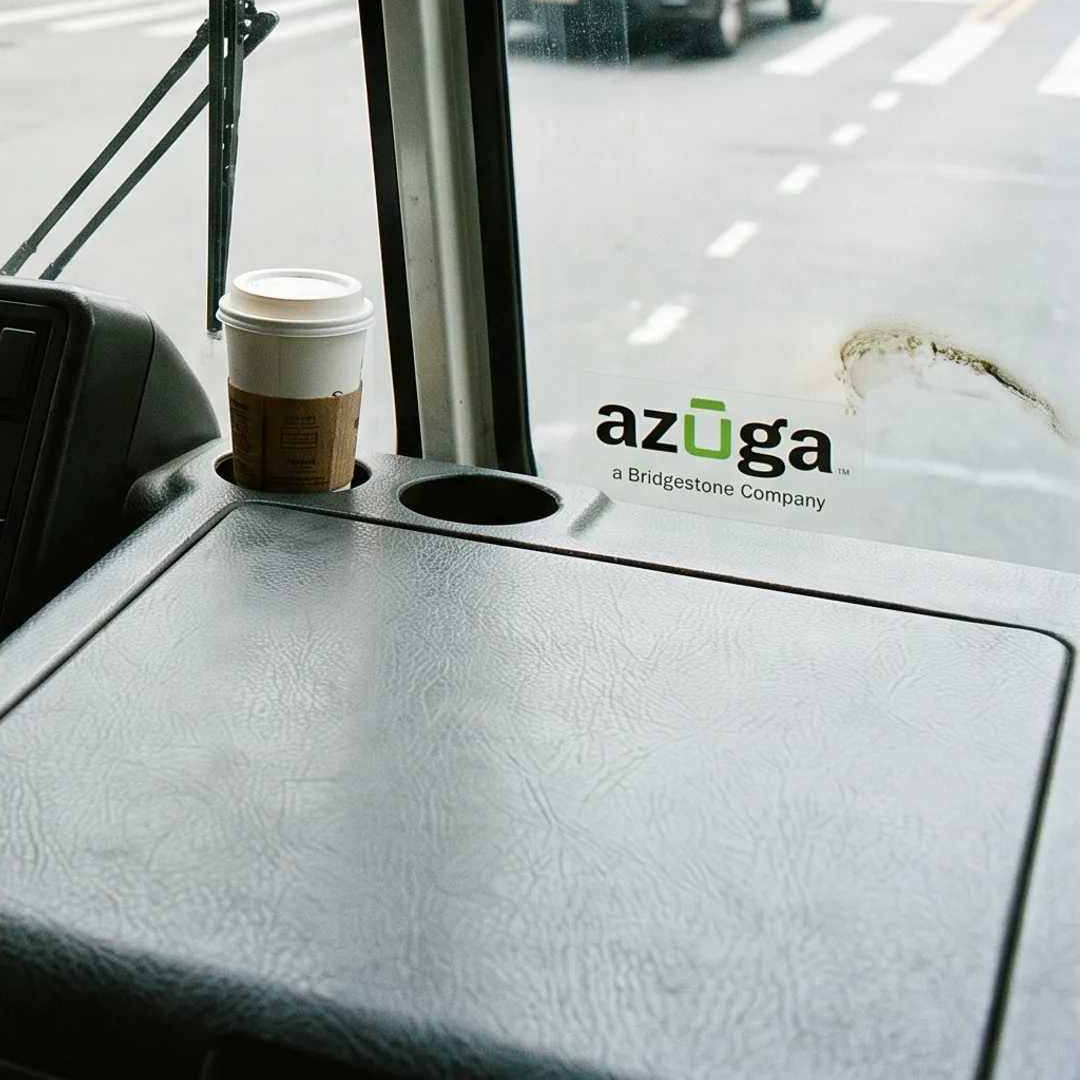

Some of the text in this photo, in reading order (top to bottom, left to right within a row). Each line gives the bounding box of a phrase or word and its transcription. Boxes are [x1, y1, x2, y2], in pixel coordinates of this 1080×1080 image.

[612, 467, 826, 512] a Bridgestone Company
